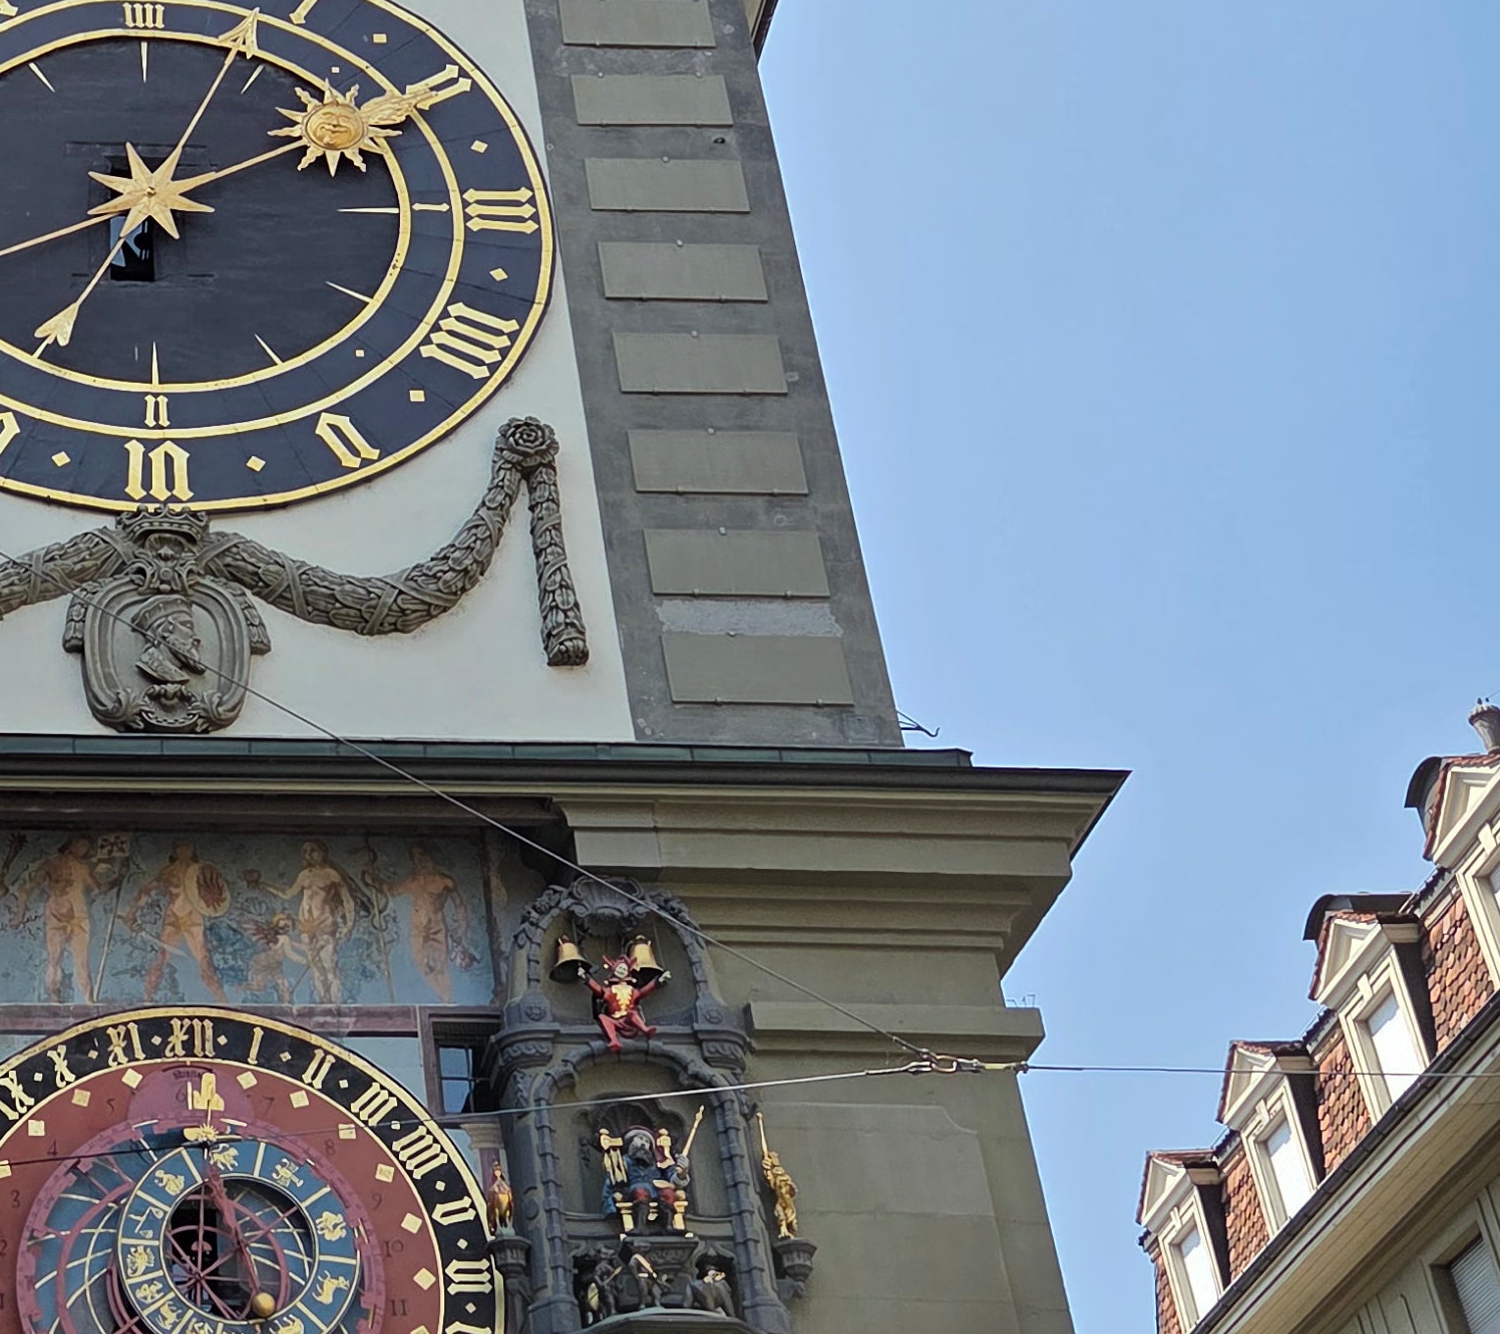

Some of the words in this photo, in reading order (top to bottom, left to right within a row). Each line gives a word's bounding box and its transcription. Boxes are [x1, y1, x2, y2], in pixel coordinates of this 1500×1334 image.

[122, 2, 164, 29] IIII
[405, 63, 473, 110] II
[462, 186, 539, 234] III
[419, 302, 520, 379] IIII
[145, 394, 170, 429] II
[123, 439, 194, 502] VI
[106, 1021, 146, 1067] XI
[164, 1017, 214, 1058] XII
[247, 1026, 264, 1065] I
[46, 1044, 77, 1088] X
[301, 1048, 336, 1090] II
[106, 1097, 116, 1117] 5
[263, 1097, 275, 1117] 7
[350, 1082, 398, 1128] III
[47, 1138, 59, 1157] 4
[324, 1138, 336, 1156] 8
[393, 1124, 448, 1180] IIII
[10, 1189, 21, 1209] 3
[383, 1239, 405, 1259] 10
